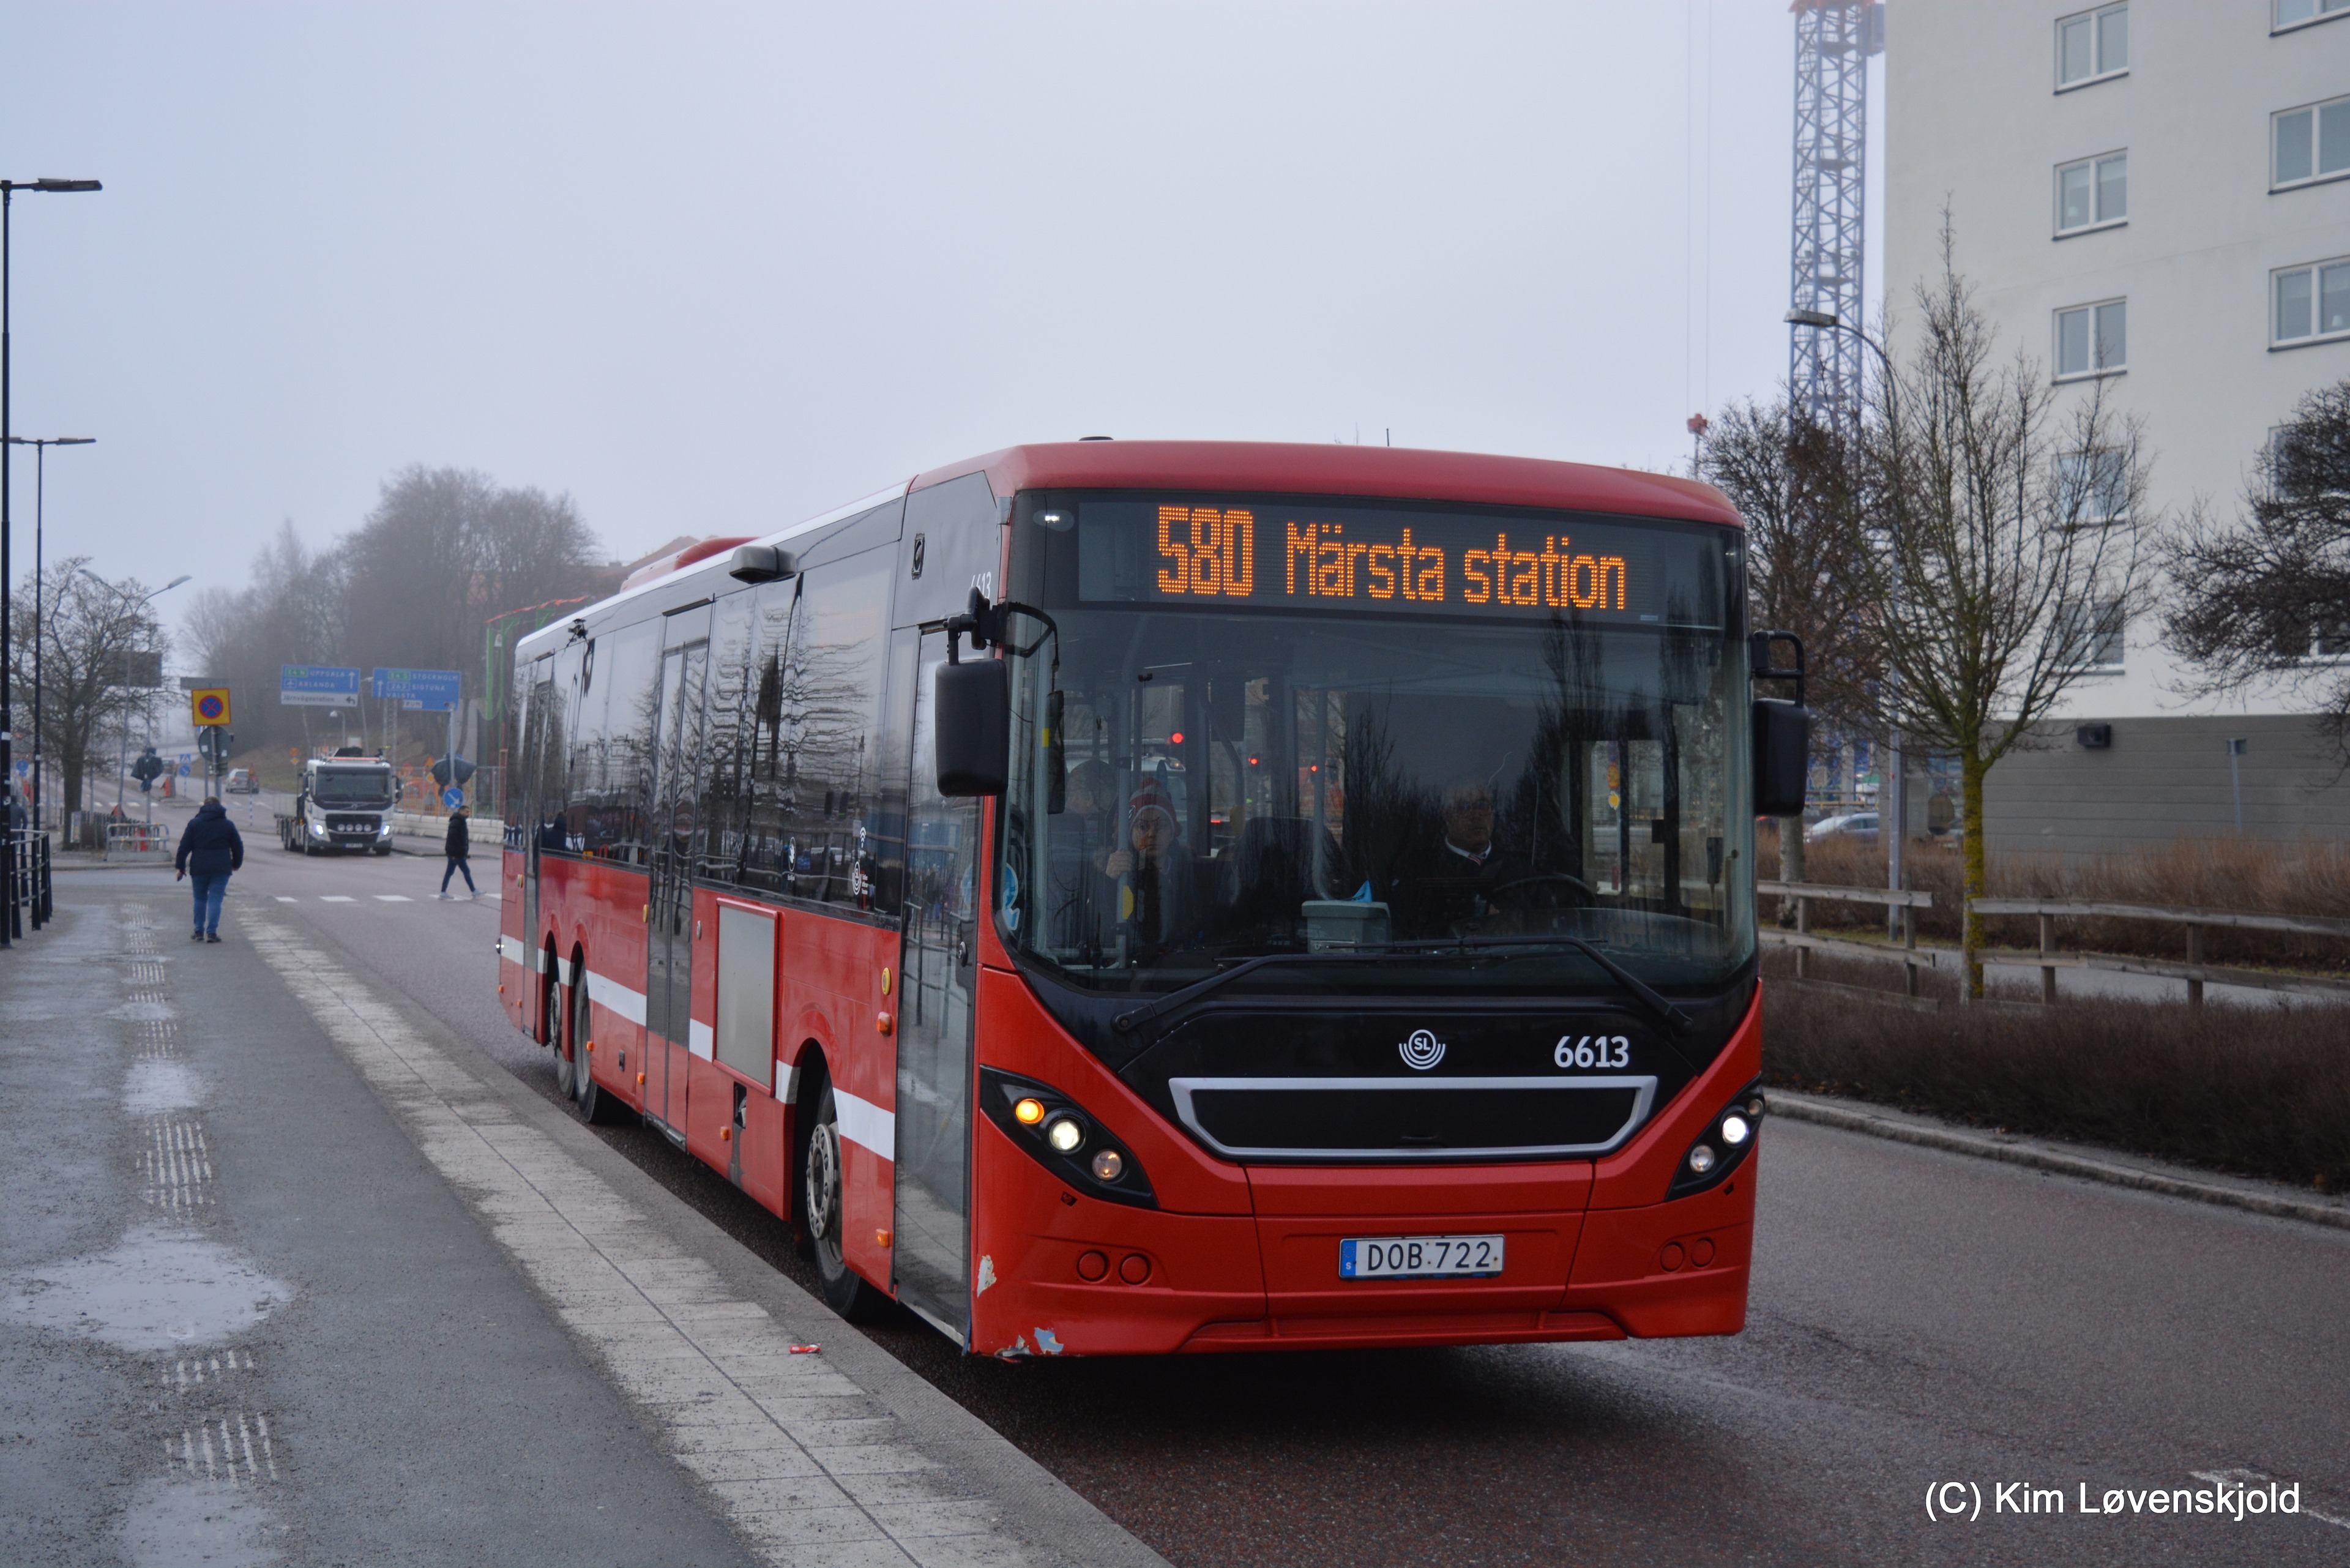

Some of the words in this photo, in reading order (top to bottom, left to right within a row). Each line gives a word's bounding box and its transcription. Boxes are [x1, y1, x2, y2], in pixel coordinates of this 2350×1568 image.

[1158, 507, 1253, 596] 580
[1287, 522, 1444, 600] Märsta
[1464, 534, 1625, 610] station
[1414, 1037, 1431, 1050] SL
[1554, 1036, 1629, 1068] 6613
[1346, 1261, 1352, 1270] S
[1368, 1243, 1422, 1271] DOB
[1435, 1241, 1490, 1269] 722
